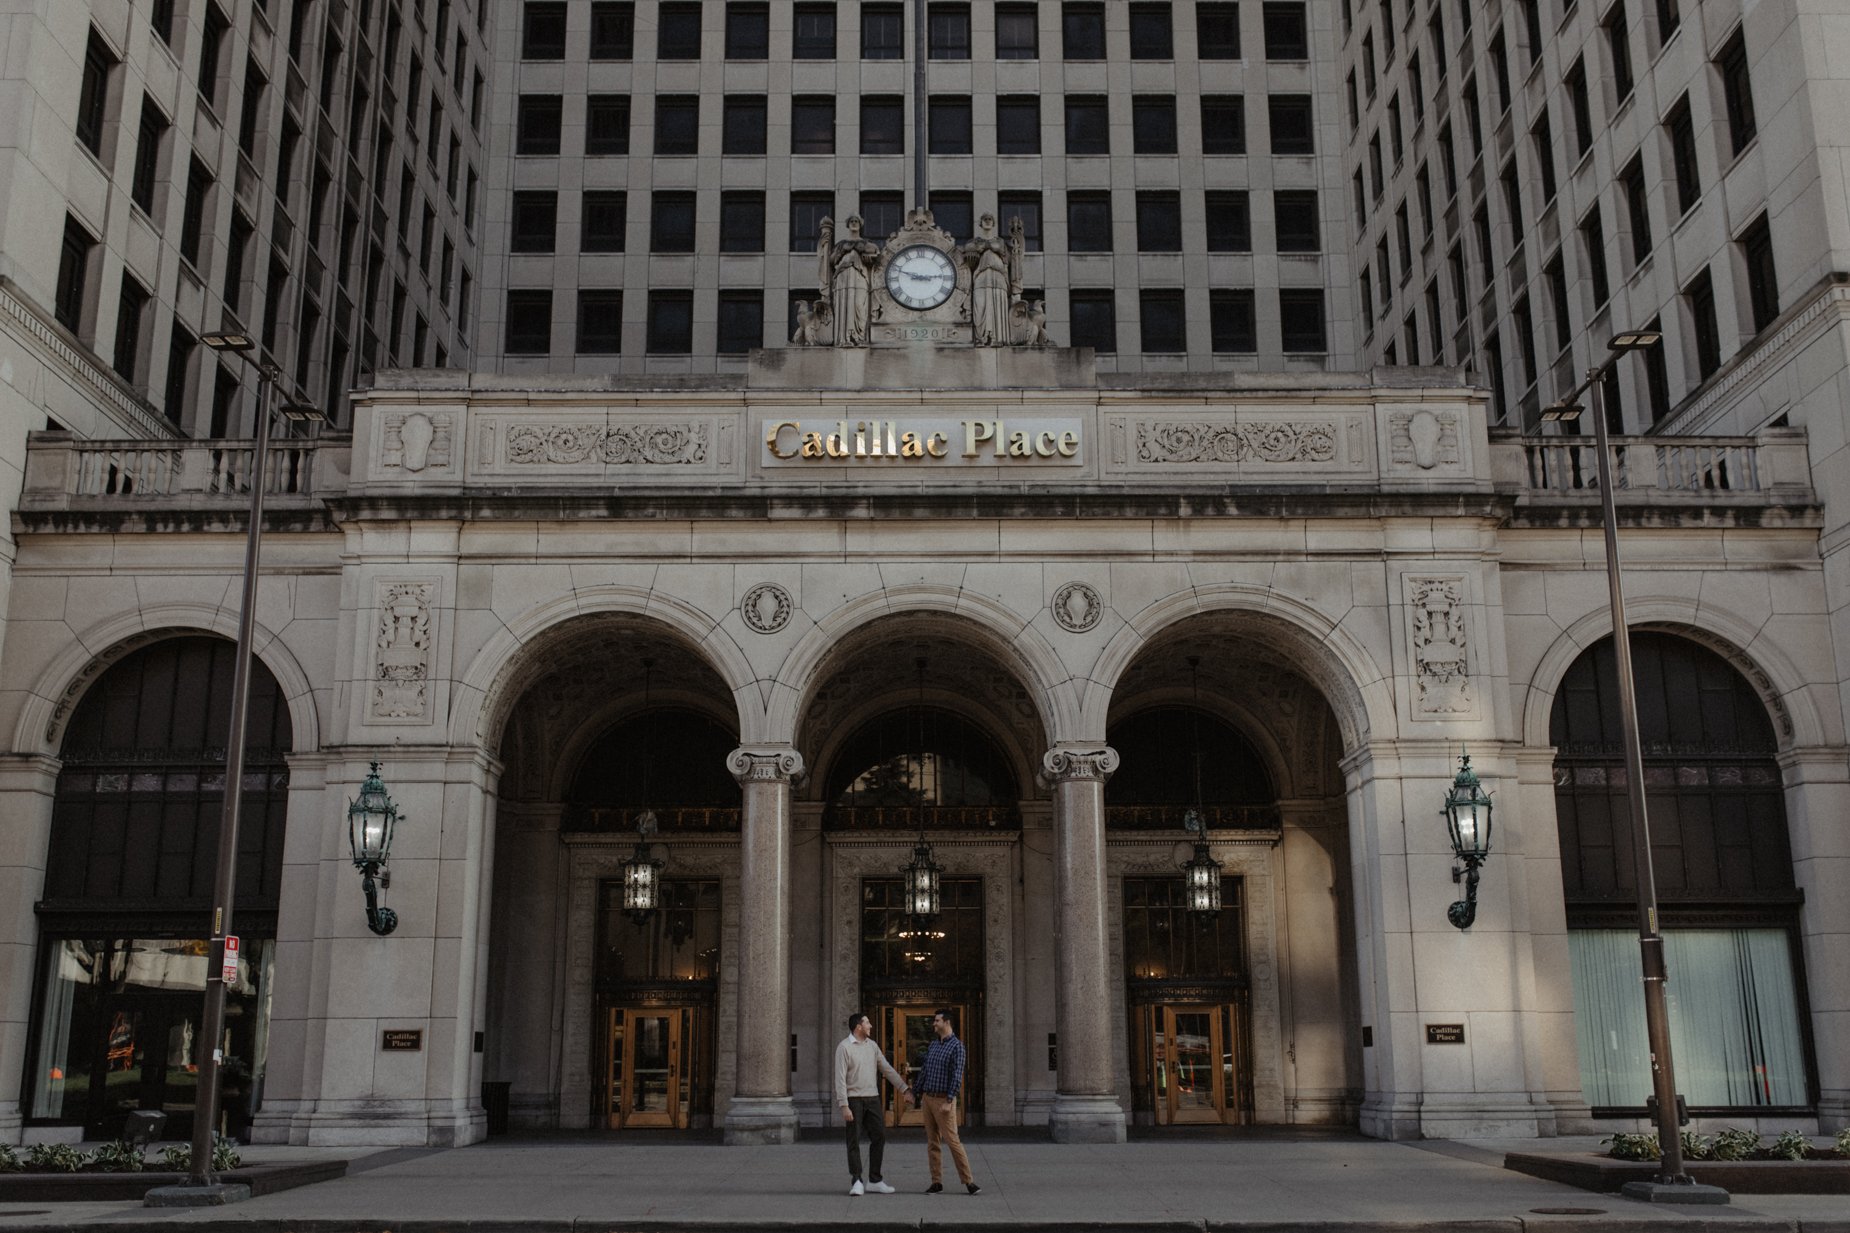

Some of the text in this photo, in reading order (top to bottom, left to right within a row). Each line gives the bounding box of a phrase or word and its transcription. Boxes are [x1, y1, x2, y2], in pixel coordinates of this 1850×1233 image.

[903, 328, 939, 339] 1920
[766, 420, 1080, 459] Cadillac Place
